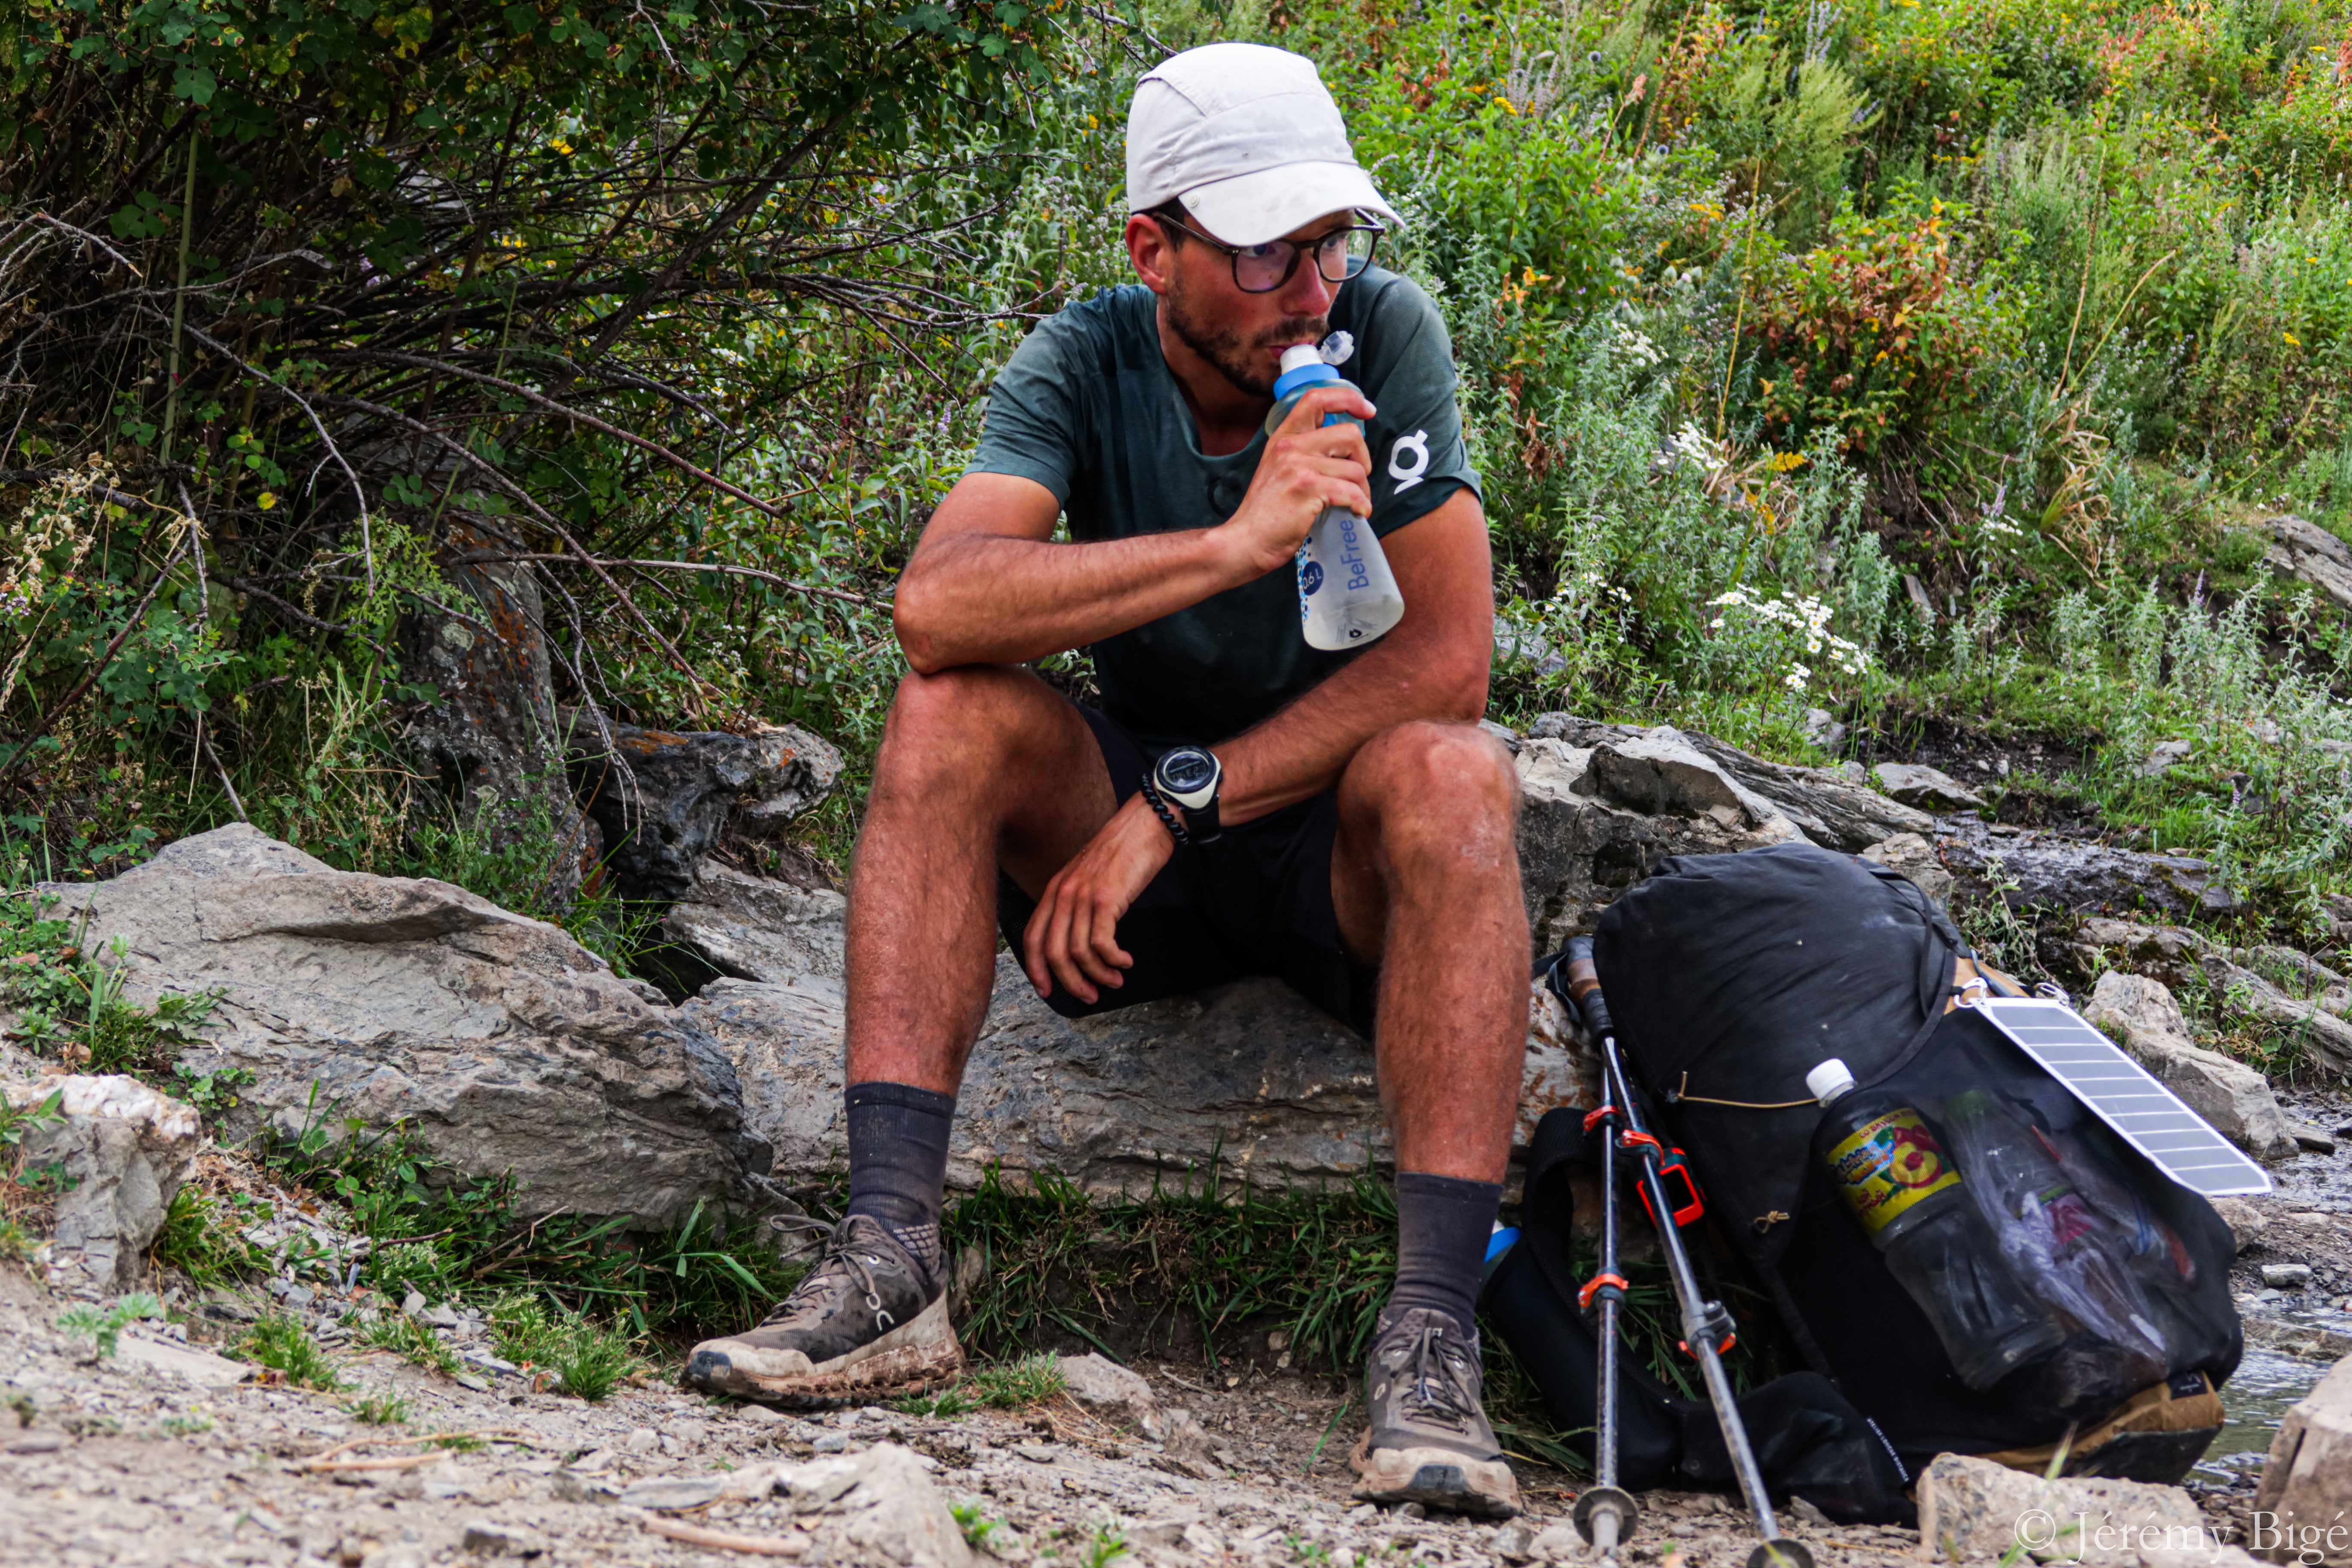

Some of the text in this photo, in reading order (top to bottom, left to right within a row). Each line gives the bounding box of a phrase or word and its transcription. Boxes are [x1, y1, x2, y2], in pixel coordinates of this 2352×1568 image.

[1303, 568, 1322, 589] 0.6 L
[1341, 520, 1370, 591] BeFree
